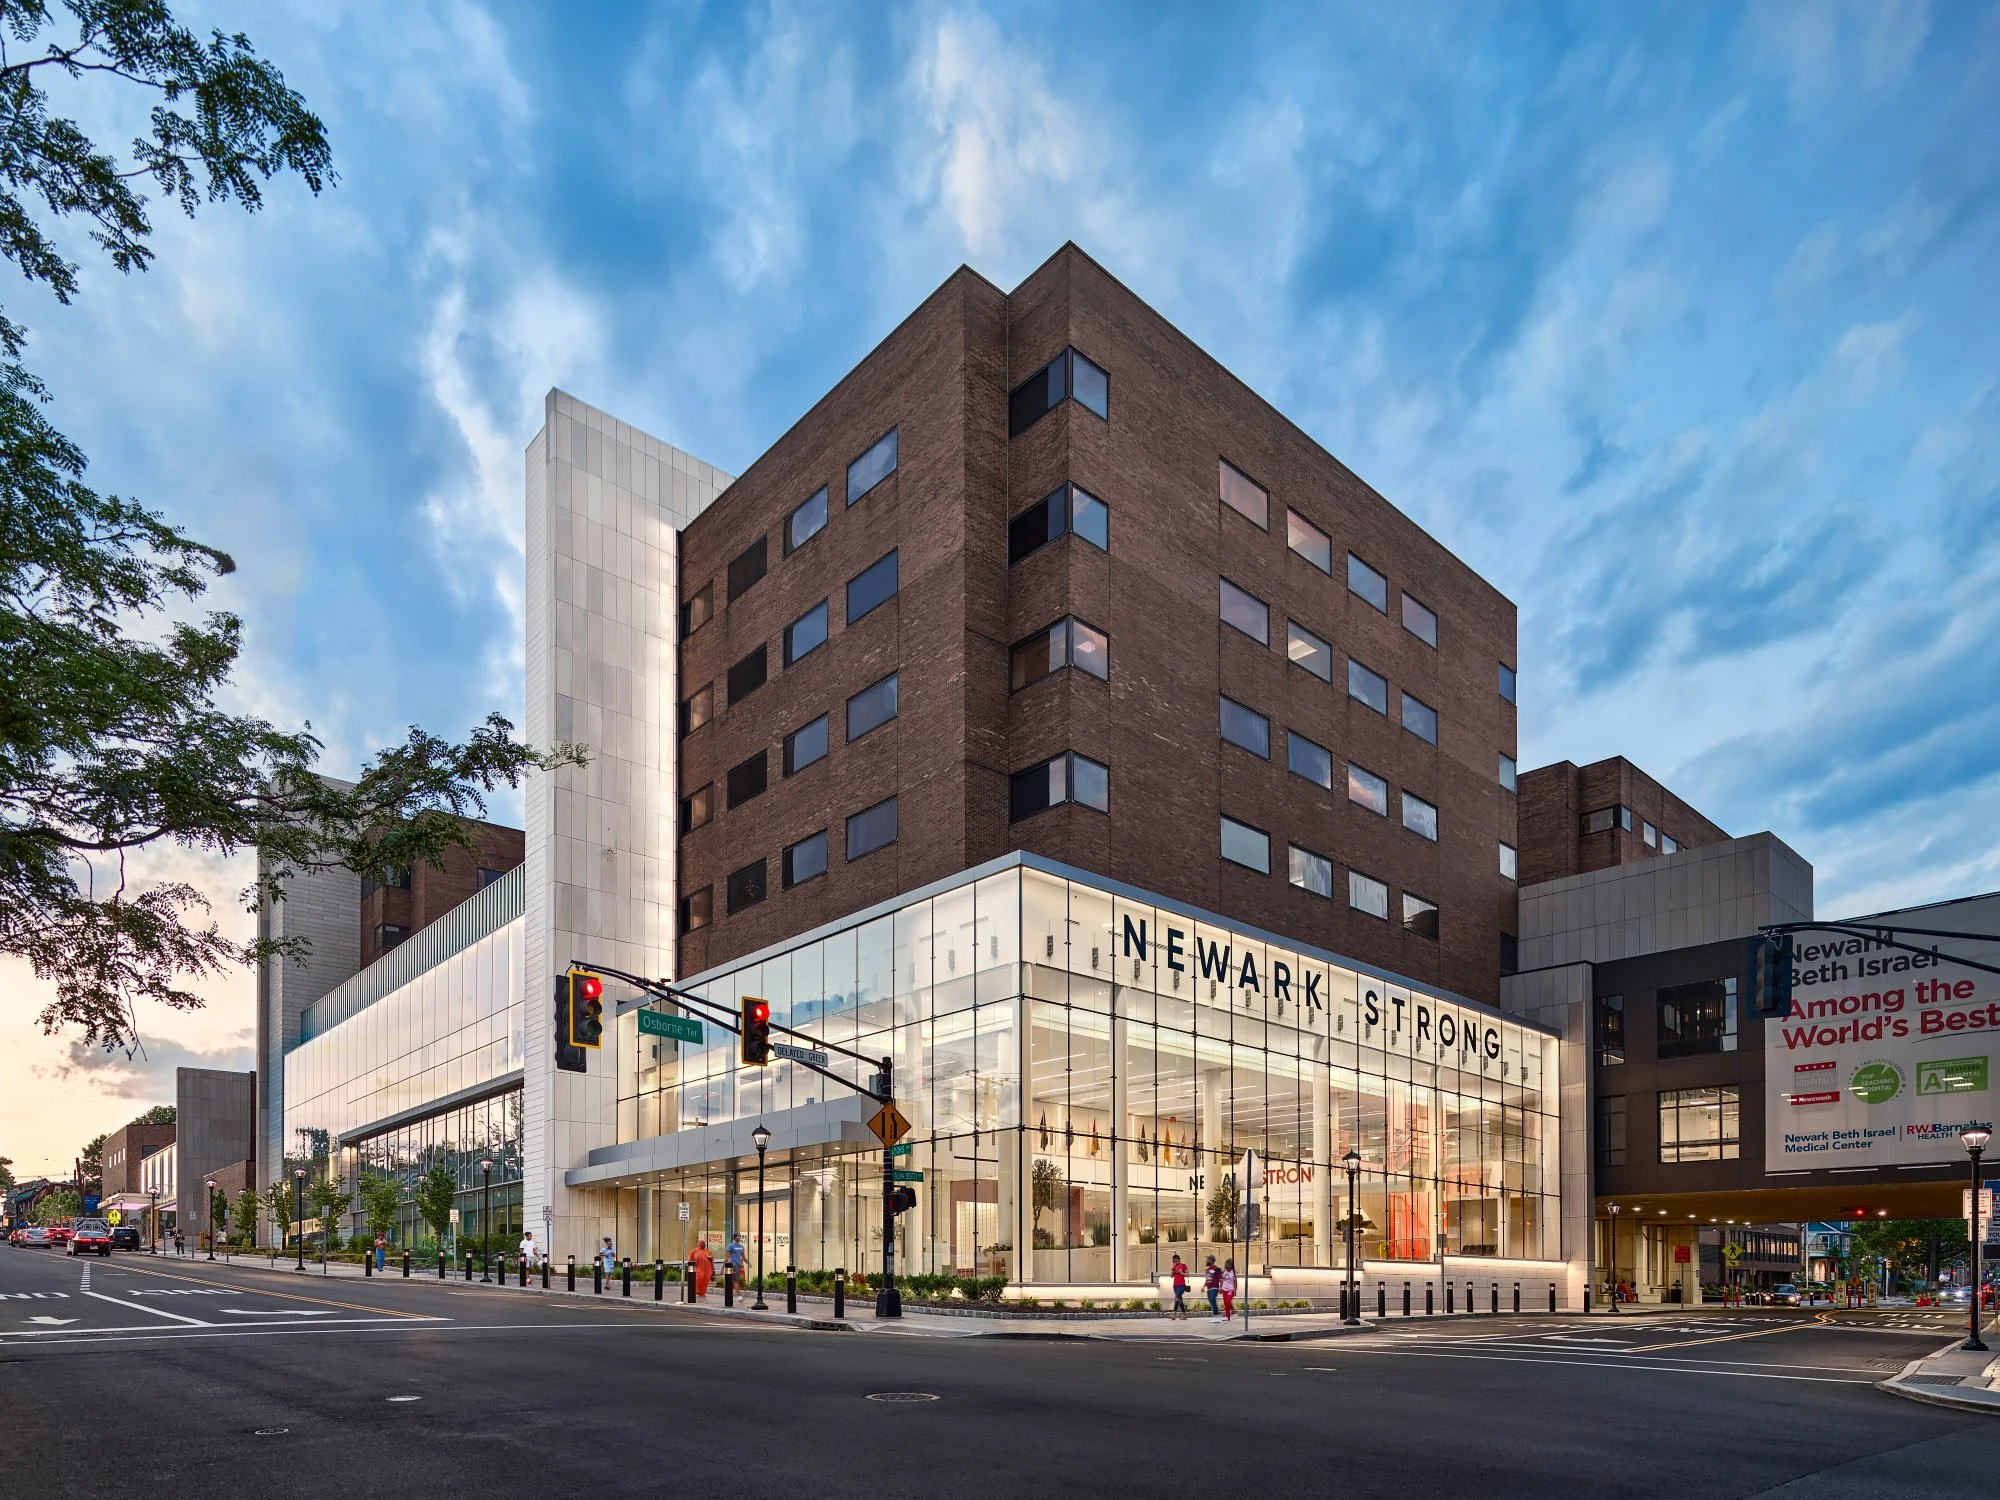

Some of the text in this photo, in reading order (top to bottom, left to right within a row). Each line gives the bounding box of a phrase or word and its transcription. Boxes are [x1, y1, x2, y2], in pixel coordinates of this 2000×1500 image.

[1792, 930, 1893, 963] Newark
[1791, 945, 1938, 987] Beth Israel
[1123, 913, 1500, 1060] NEWARK STRONG
[1782, 978, 1975, 1022] Among the
[643, 1015, 698, 1038] Osborne Ter
[1782, 1003, 2000, 1050] World's Best
[777, 1046, 826, 1064] DELAYED GREEN
[1861, 1078, 1894, 1086] TEACHING
[1924, 1073, 1942, 1091] A
[1785, 1126, 1896, 1143] Newark Beth Israel
[1918, 1131, 1953, 1140] HEALTH
[1785, 1140, 1874, 1154] Medical Center
